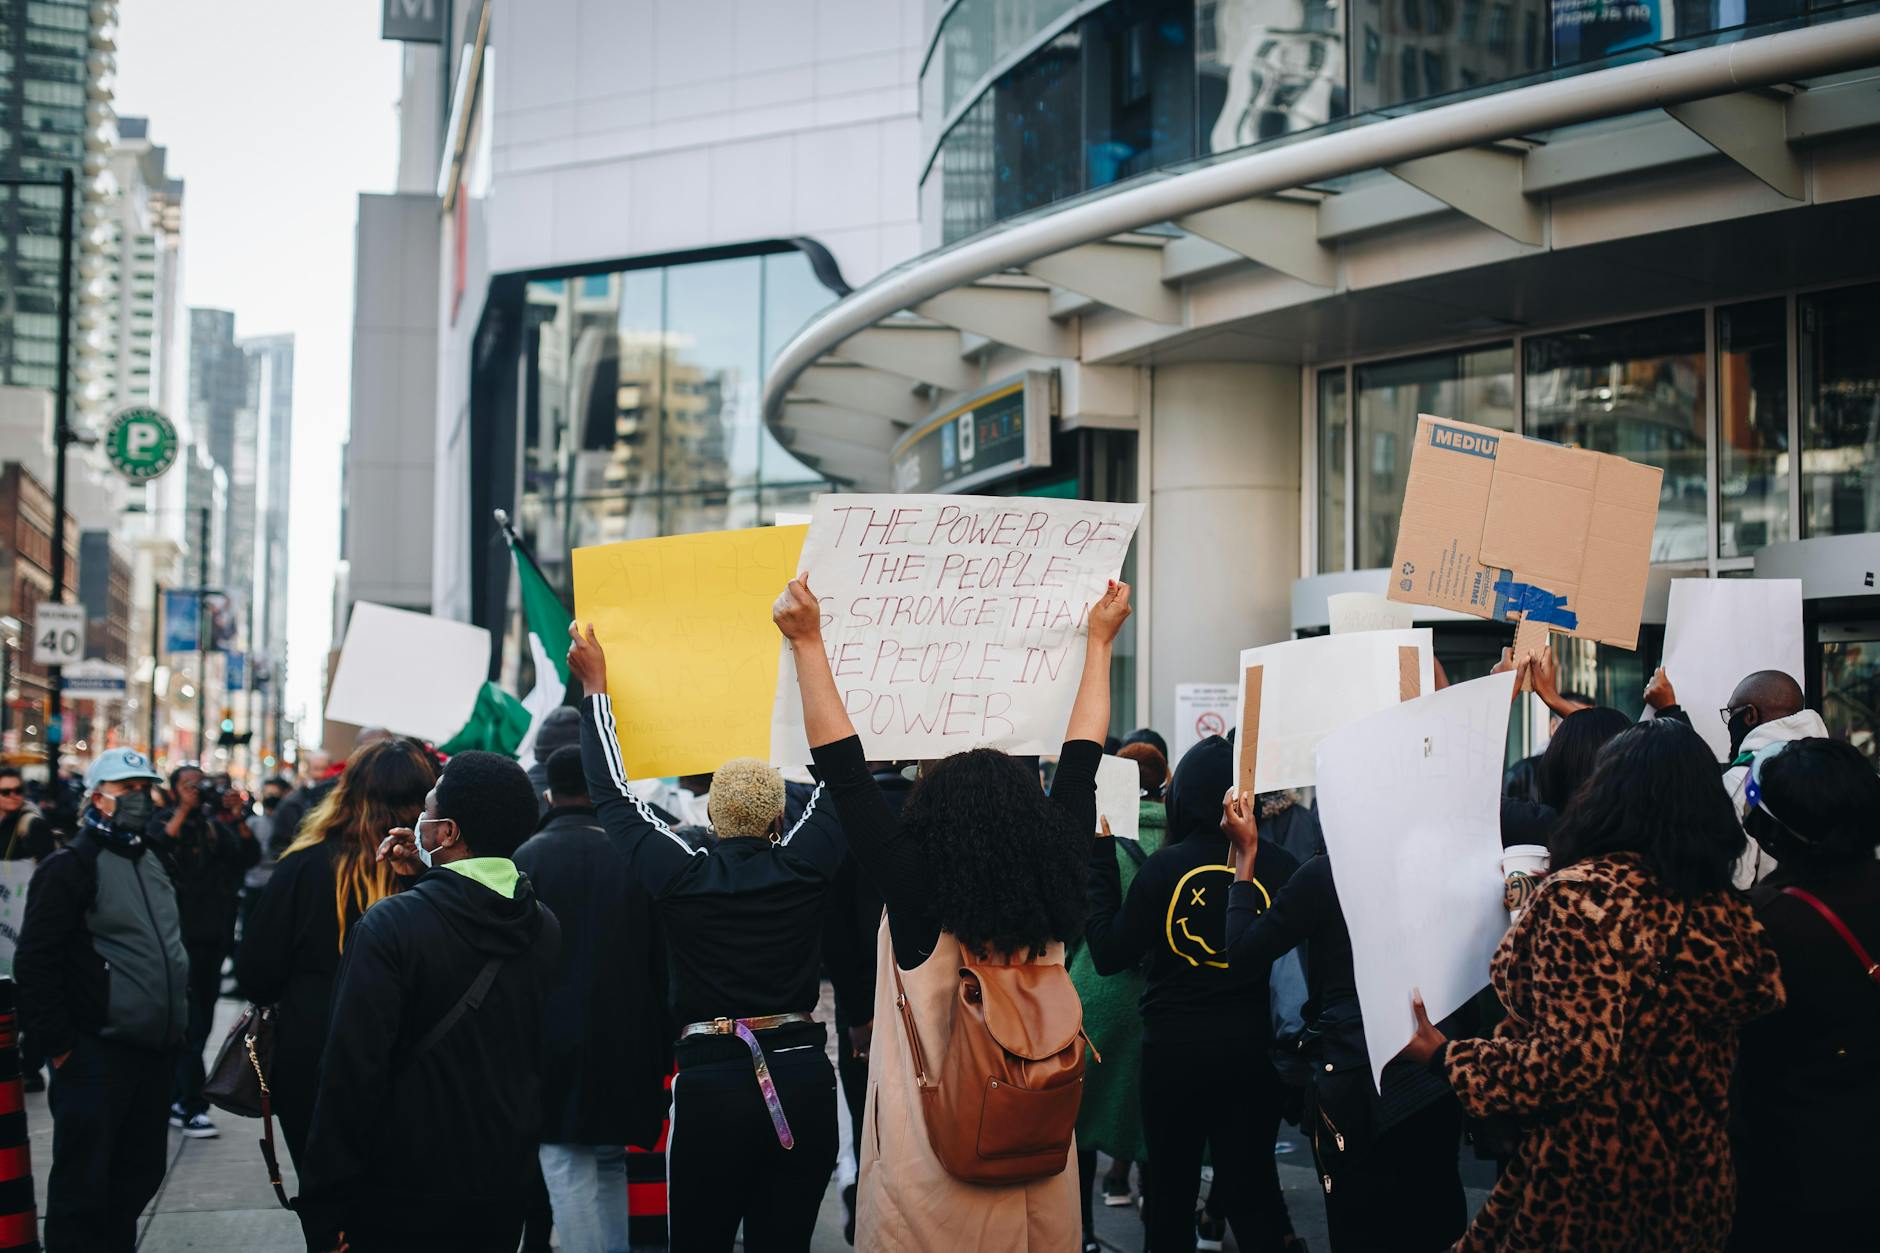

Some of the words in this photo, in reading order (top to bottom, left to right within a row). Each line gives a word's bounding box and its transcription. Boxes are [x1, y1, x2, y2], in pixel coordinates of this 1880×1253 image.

[128, 421, 160, 459] P
[1435, 429, 1498, 456] MEDIU
[833, 505, 923, 548] THE
[927, 505, 1049, 547] POWER
[1064, 519, 1120, 555] OF
[858, 552, 926, 585] THE
[936, 550, 1072, 590] PEOPLE
[1470, 571, 1483, 605] PRIME
[817, 597, 835, 629] S
[849, 595, 998, 629] STRONGE
[39, 629, 78, 655] 40
[870, 640, 1004, 685] PEOPLE
[1012, 647, 1068, 685] IN
[844, 689, 1015, 737] POWER
